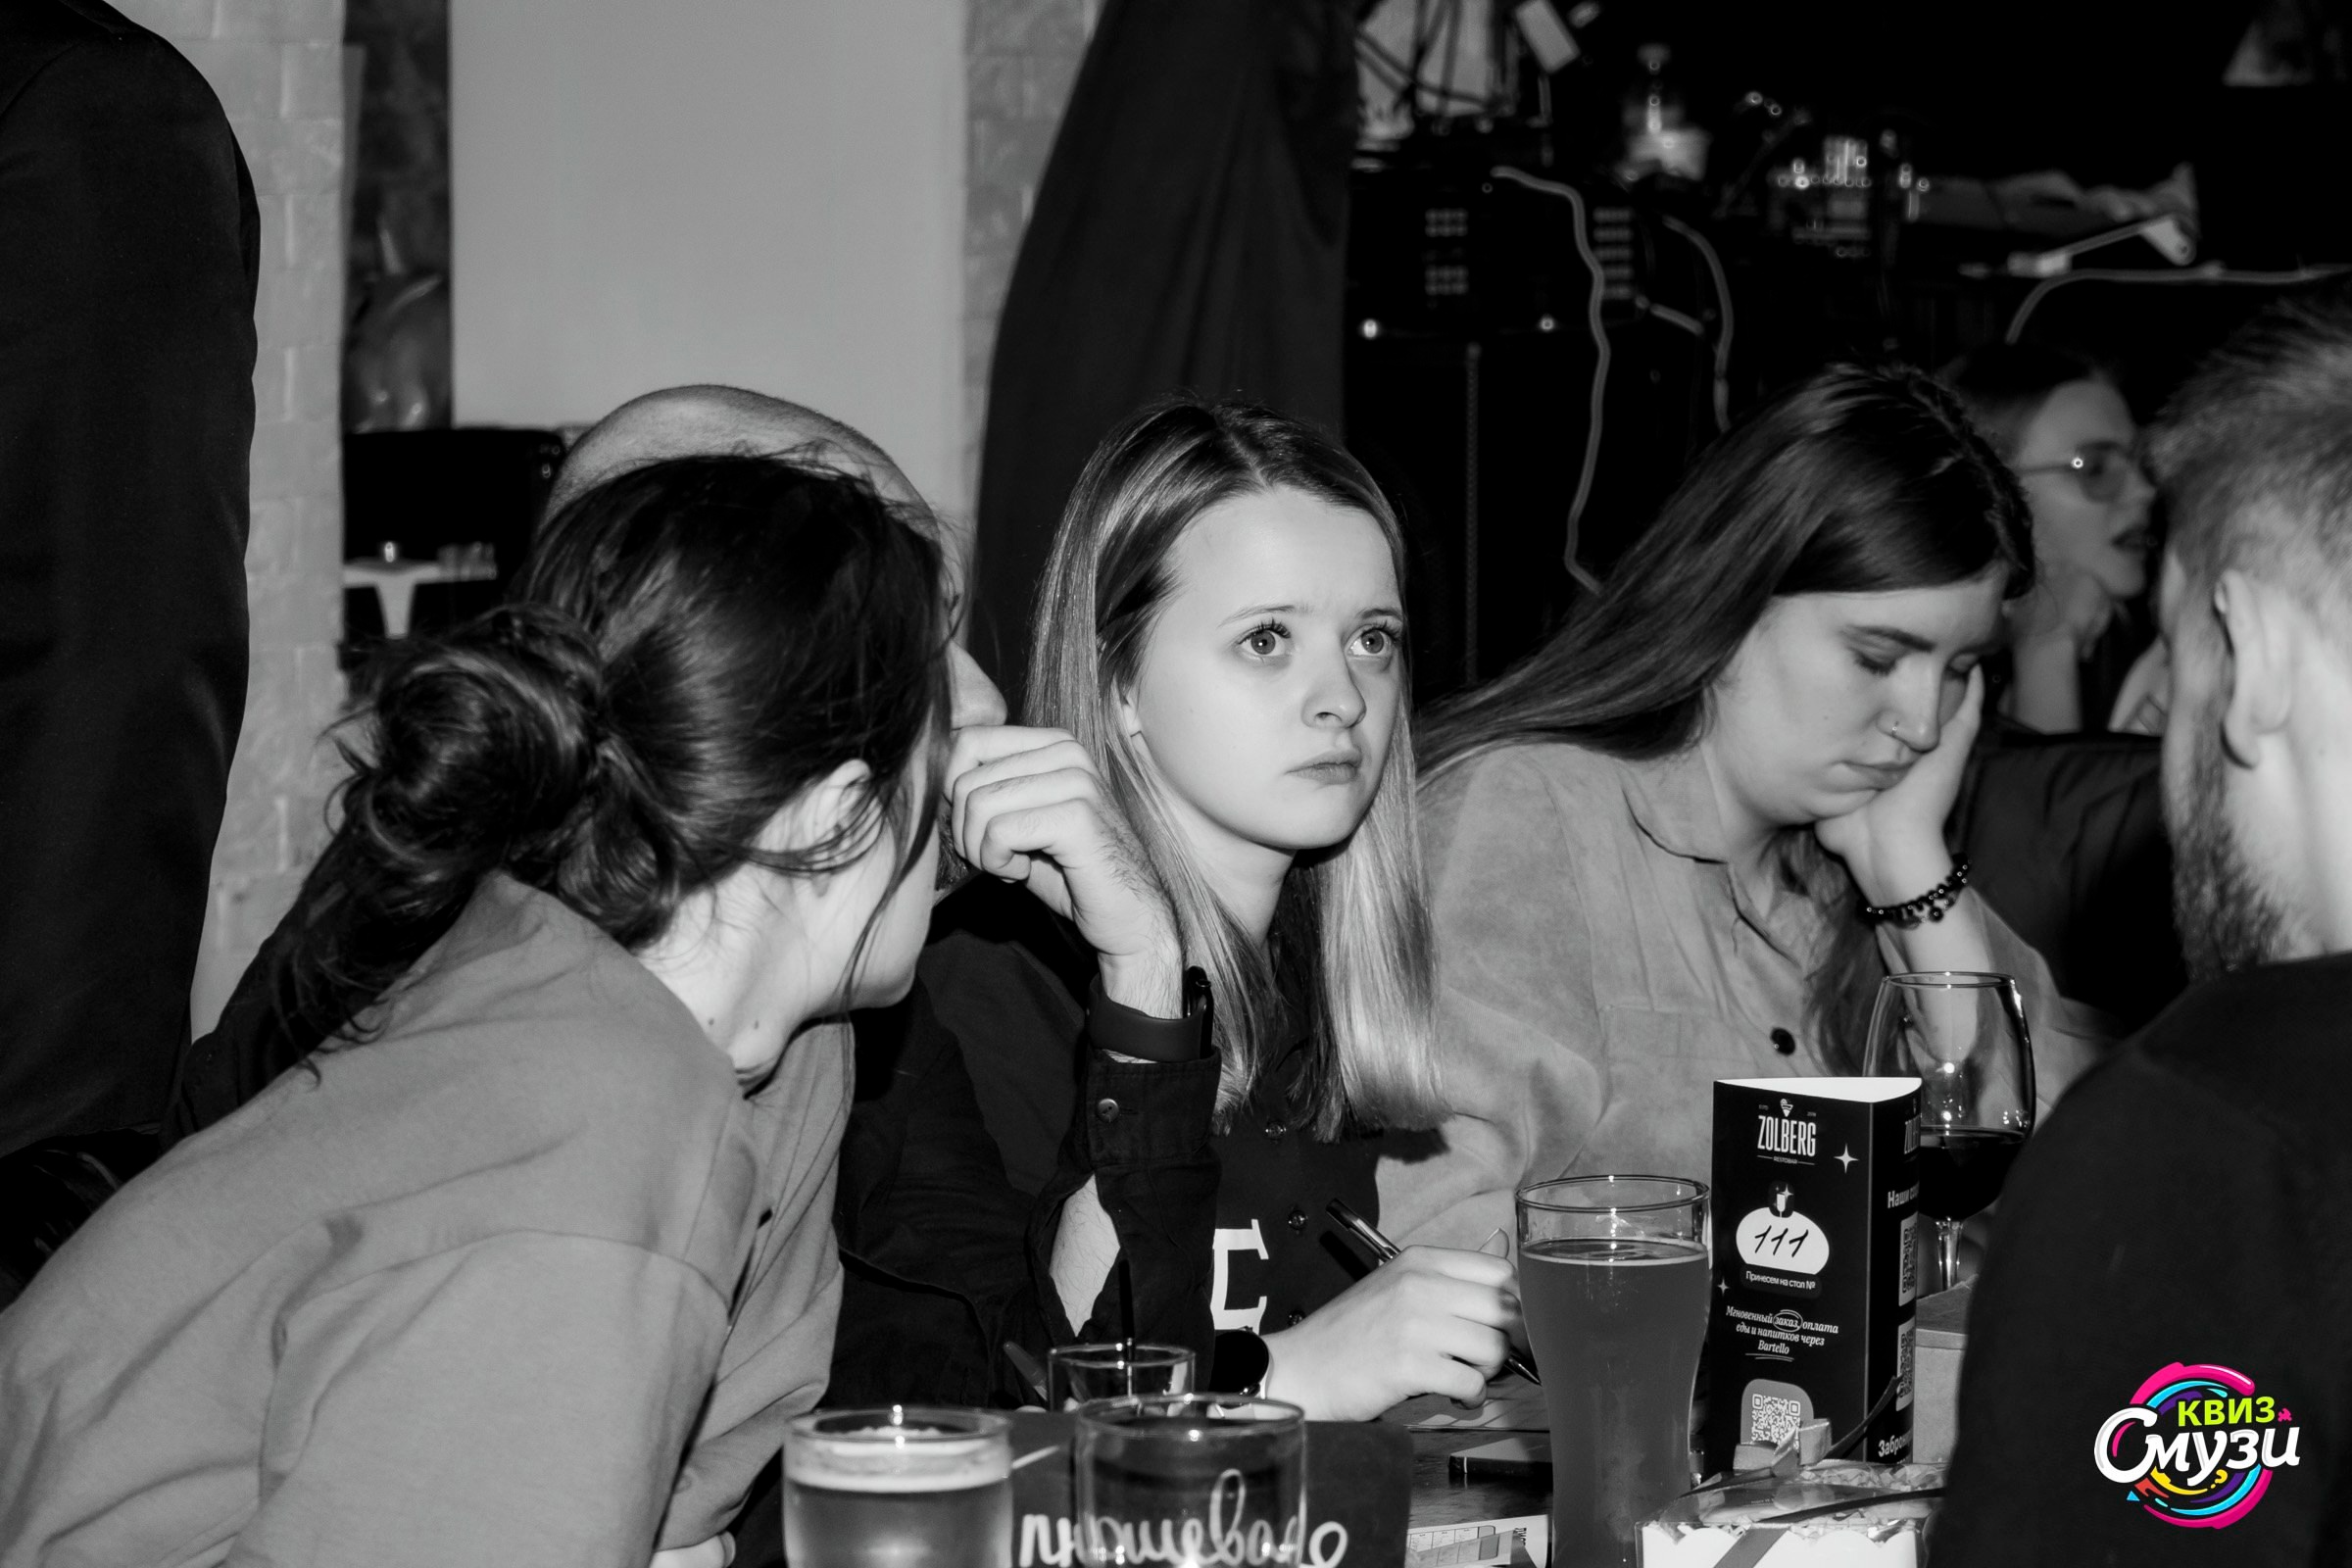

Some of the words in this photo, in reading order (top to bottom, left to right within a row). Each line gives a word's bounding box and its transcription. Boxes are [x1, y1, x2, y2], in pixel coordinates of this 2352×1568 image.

[1757, 1114, 1817, 1157] ZOLBERG
[1754, 1225, 1809, 1258] 111
[1780, 1278, 1788, 1287] на
[1788, 1280, 1805, 1289] стол
[1725, 1305, 1773, 1324] Мгновенный
[1802, 1320, 1839, 1335] оплата
[1736, 1321, 1750, 1335] еды
[1750, 1327, 1757, 1336] и
[1757, 1328, 1800, 1343] напитков
[1800, 1334, 1826, 1348] через
[1757, 1340, 1790, 1355] Bartello
